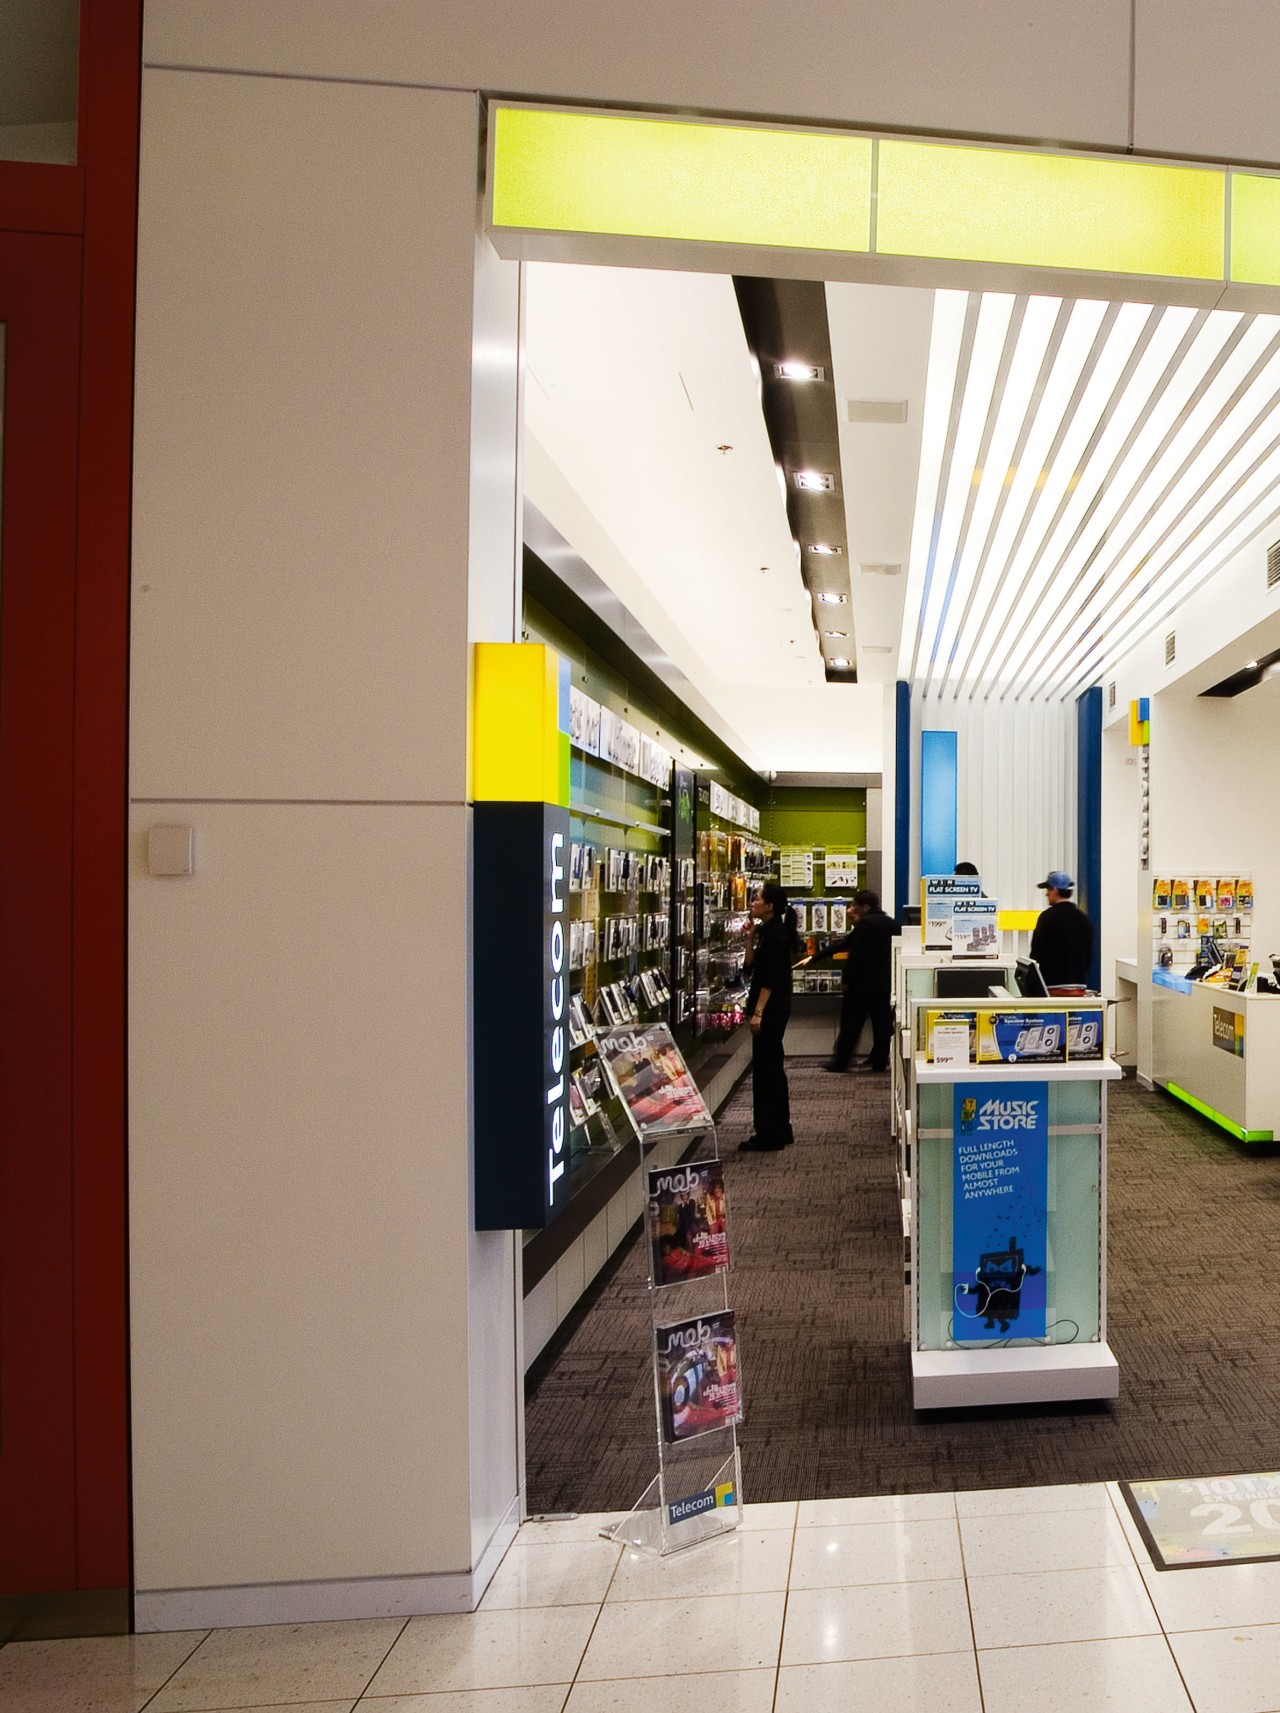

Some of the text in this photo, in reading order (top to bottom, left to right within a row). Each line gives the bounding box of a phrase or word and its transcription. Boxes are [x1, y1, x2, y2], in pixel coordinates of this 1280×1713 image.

[548, 832, 564, 1206] Telecom
[1214, 1014, 1234, 1040] Telecom
[600, 1032, 647, 1056] mob
[980, 1099, 1040, 1115] MUSIC
[977, 1115, 1038, 1130] STORE
[958, 1140, 1014, 1154] FULL LENGTH
[960, 1148, 1018, 1164] DOWNLOADS
[961, 1160, 1004, 1172] FOR YOUR
[962, 1166, 1020, 1181] MOBILE FROM
[649, 1167, 700, 1197] mob
[964, 1178, 998, 1190] ALMOST
[964, 1185, 1014, 1200] ANYWHERE
[659, 1320, 711, 1354] mob
[670, 1496, 714, 1518] Telecom
